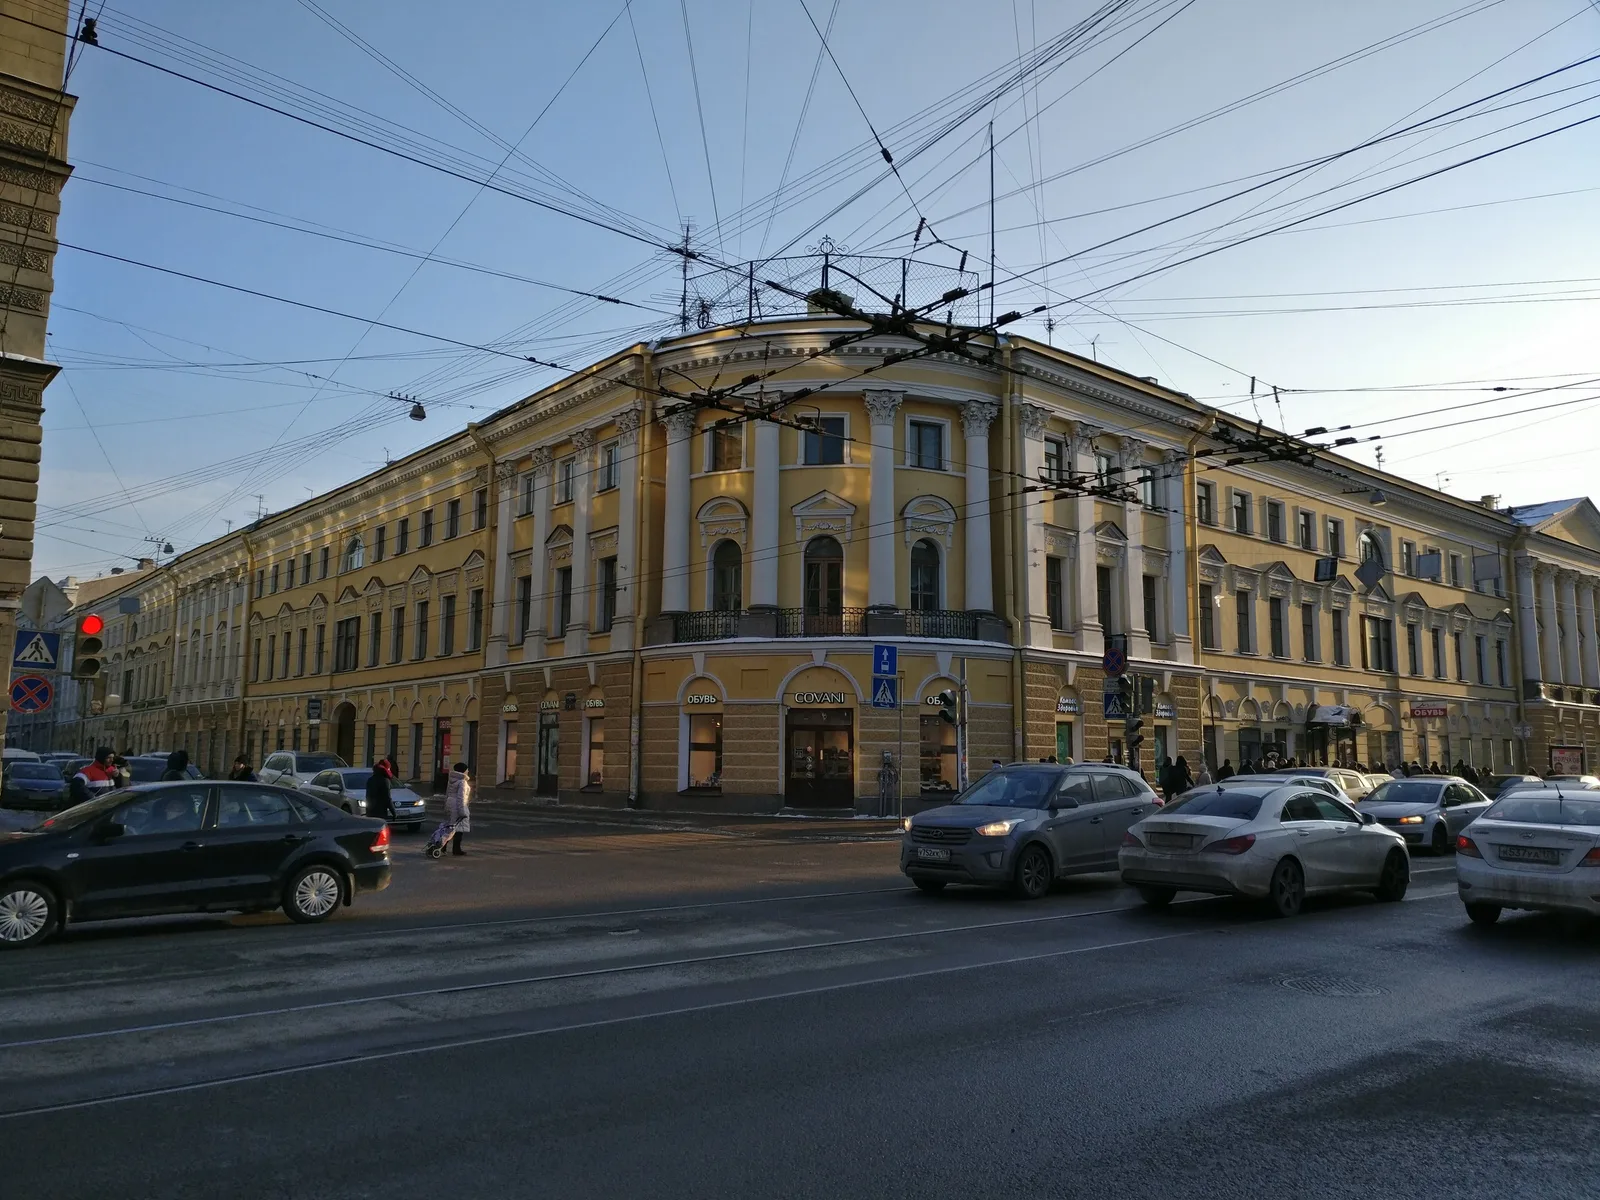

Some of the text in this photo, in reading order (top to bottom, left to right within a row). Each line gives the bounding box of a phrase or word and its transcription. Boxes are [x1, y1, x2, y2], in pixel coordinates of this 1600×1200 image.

[687, 695, 716, 704] ОБУВЬ
[795, 692, 844, 703] COVANI
[585, 699, 604, 708] ОБУВЬ
[502, 704, 518, 713] ОБУВЬ
